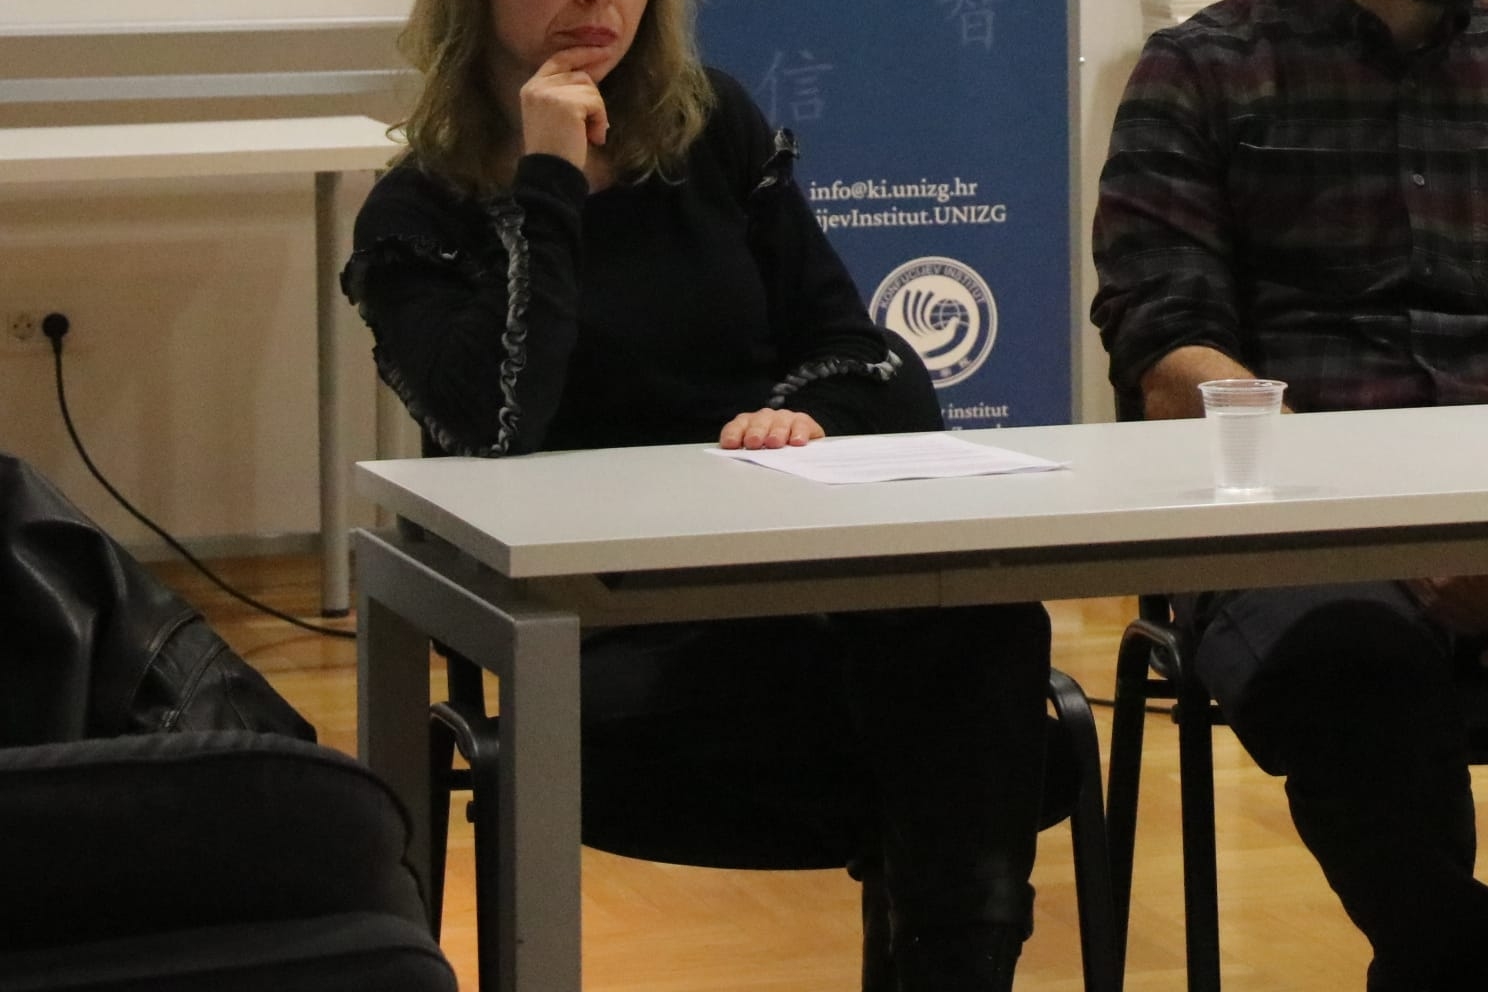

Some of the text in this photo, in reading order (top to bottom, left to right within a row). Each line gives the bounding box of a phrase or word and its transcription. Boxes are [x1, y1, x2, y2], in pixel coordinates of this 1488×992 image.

[754, 50, 833, 126] 信
[809, 177, 978, 202] info@ki.unizg.hr
[816, 205, 1007, 233] ijevInstitut.UNIZG
[948, 401, 1009, 420] institut
